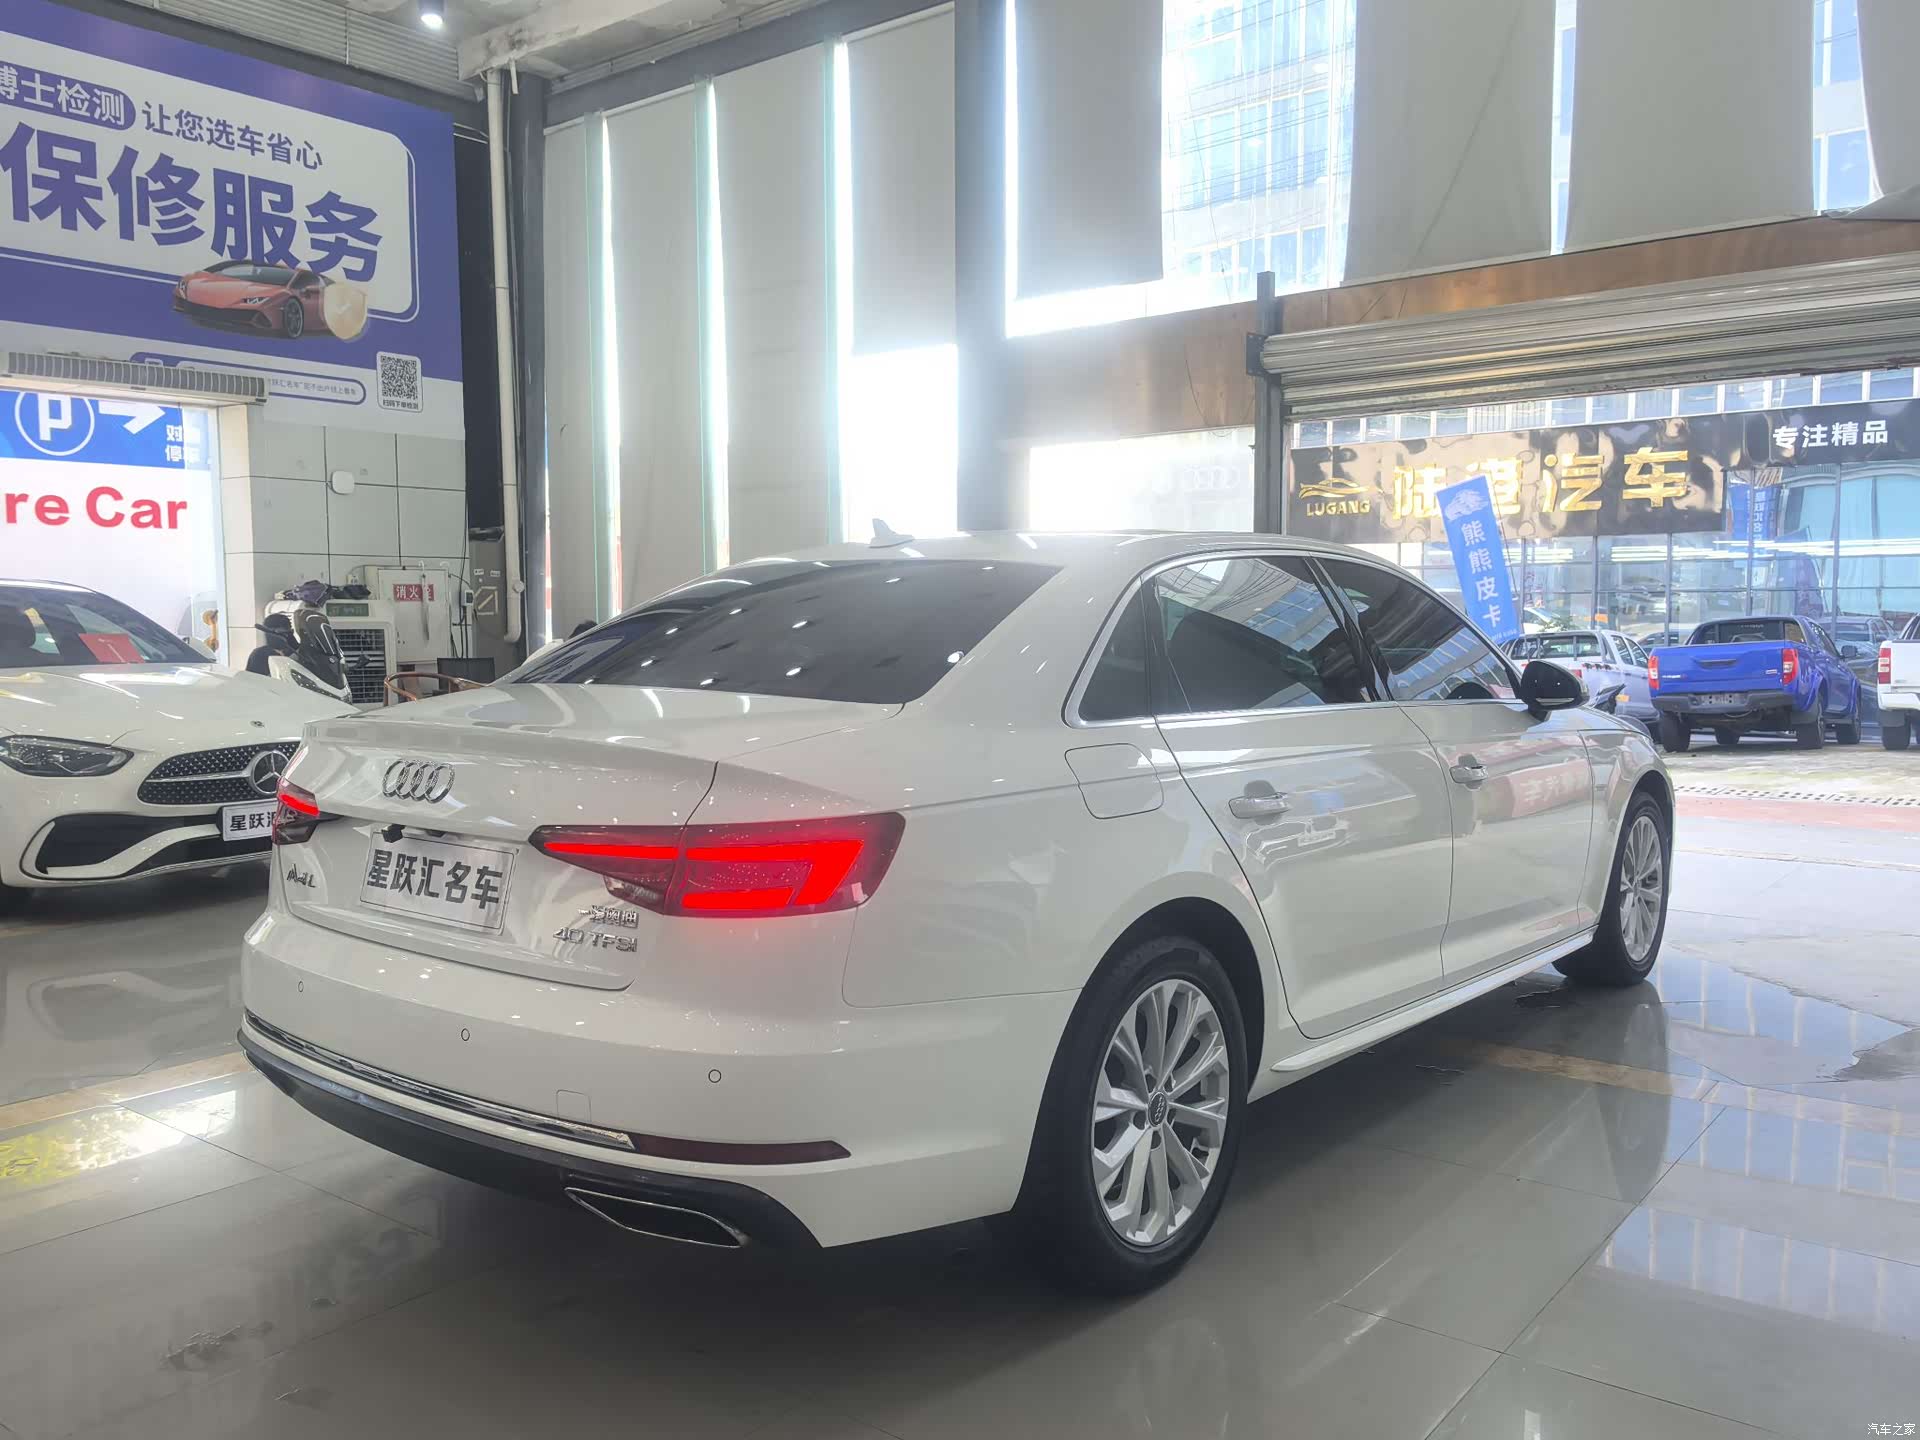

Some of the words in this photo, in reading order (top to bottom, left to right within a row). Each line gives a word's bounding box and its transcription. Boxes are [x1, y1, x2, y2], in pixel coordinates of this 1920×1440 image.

[142, 102, 323, 170] 让您选车省心
[0, 121, 383, 282] 保修服务
[1773, 420, 1889, 450] 专注精品
[86, 486, 188, 530] Car
[1306, 500, 1371, 517] LUGANG
[1461, 520, 1502, 629] 熊熊皮卡
[367, 849, 503, 910] 星跃汇名车
[553, 926, 584, 945] 40
[588, 931, 638, 953] TFSI
